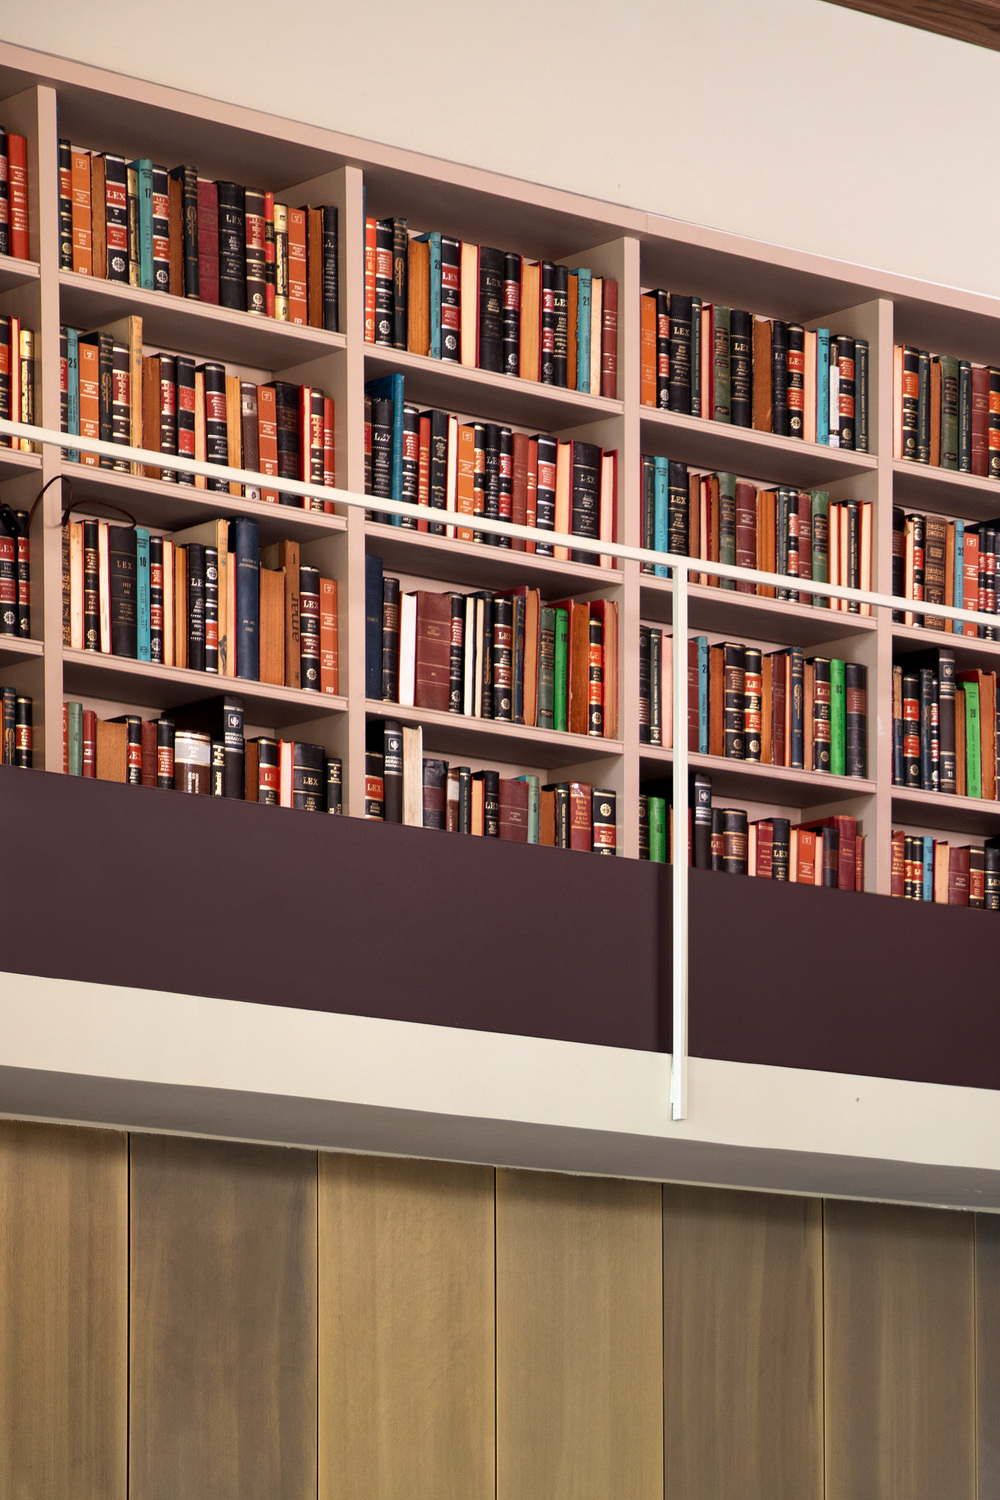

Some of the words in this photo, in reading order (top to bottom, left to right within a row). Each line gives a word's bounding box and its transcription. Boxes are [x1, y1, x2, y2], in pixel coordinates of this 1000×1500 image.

[107, 190, 127, 202] LEX
[144, 187, 153, 199] 17
[226, 213, 243, 225] LEX
[674, 326, 690, 337] LEX
[68, 357, 78, 370] 25
[671, 495, 687, 505] LEX
[18, 543, 28, 553] LE
[116, 560, 133, 570] LEX
[139, 555, 148, 568] 10
[191, 577, 203, 588] LE
[291, 593, 300, 643] amar
[264, 773, 277, 782] LE
[303, 776, 319, 787] LEX
[366, 783, 382, 793] LEX
